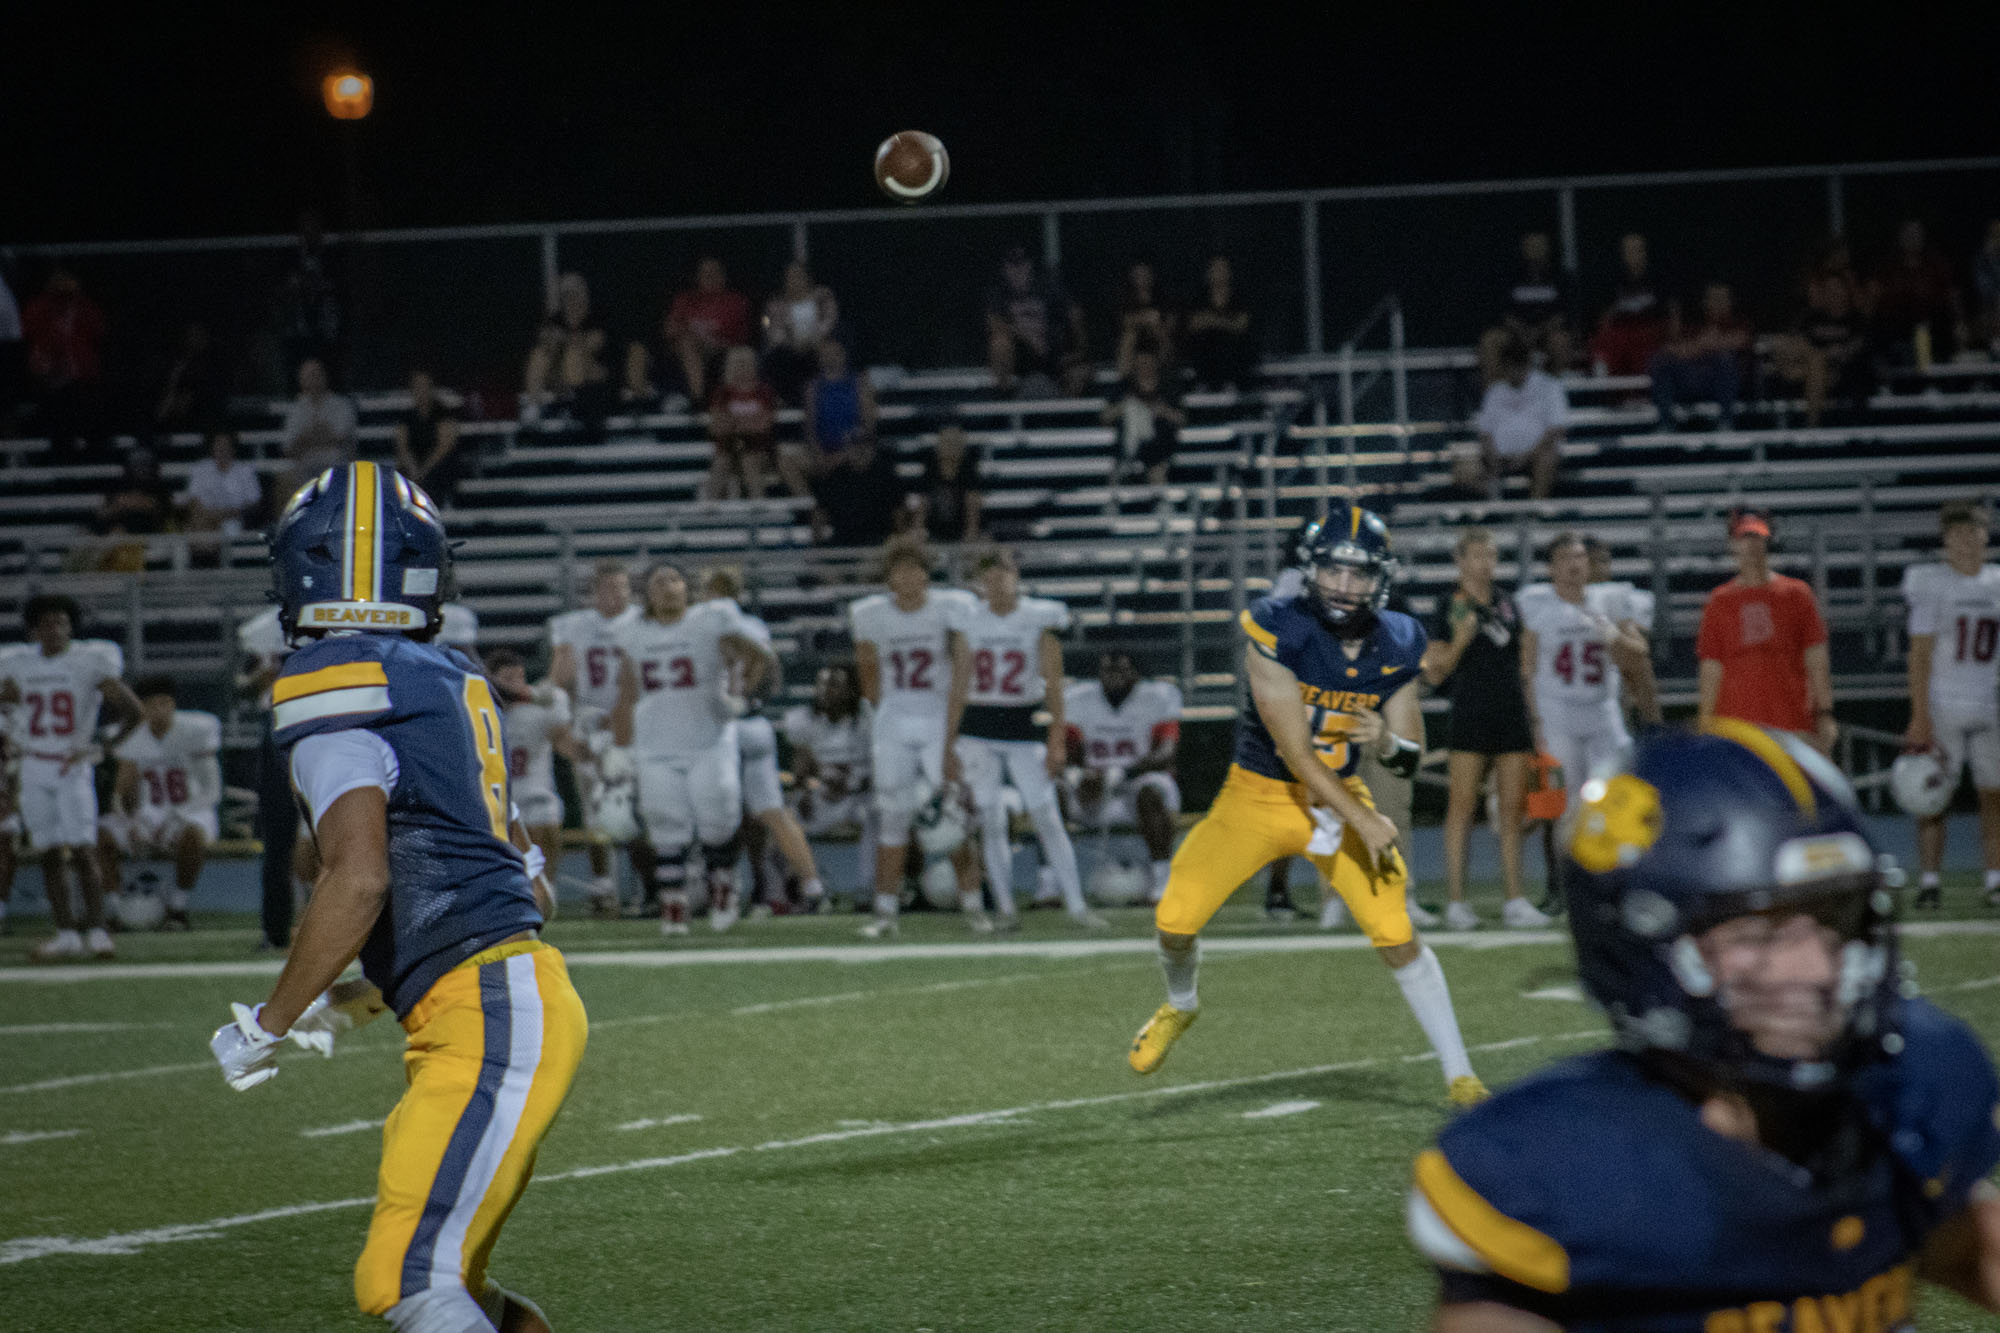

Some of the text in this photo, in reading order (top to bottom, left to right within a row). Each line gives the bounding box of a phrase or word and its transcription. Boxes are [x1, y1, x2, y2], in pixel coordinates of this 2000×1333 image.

[313, 607, 411, 625] BEAVERS
[1957, 616, 1998, 663] 10
[891, 650, 933, 690] 12
[1555, 642, 1604, 684] 45
[26, 692, 74, 736] 29
